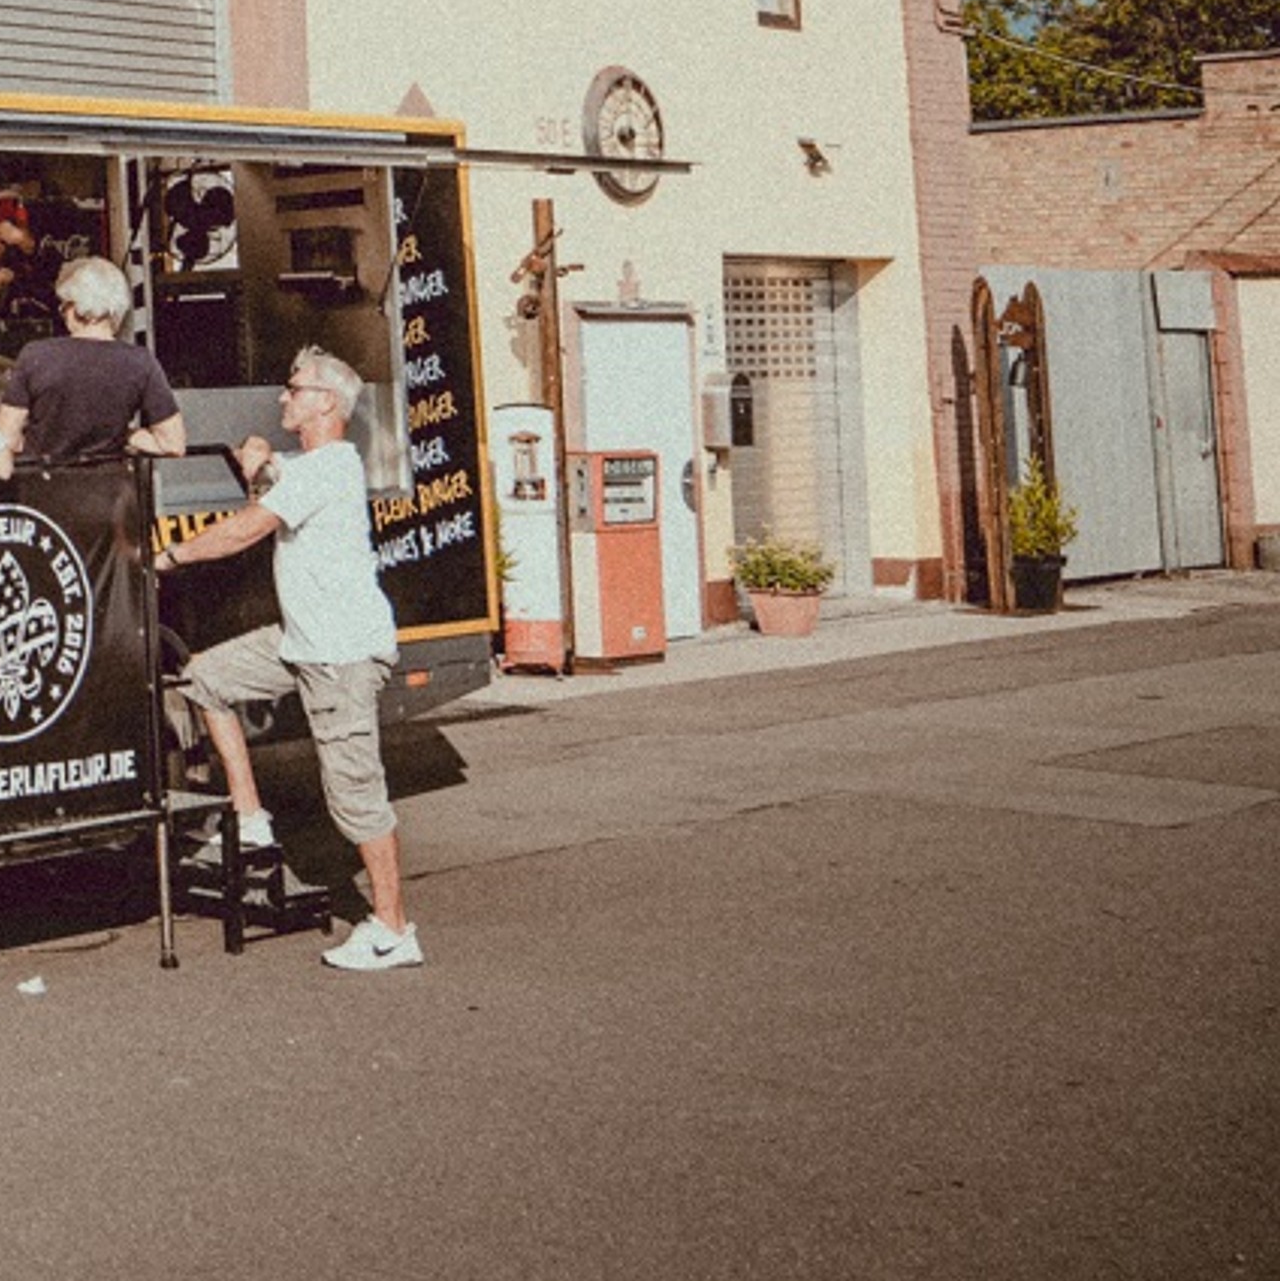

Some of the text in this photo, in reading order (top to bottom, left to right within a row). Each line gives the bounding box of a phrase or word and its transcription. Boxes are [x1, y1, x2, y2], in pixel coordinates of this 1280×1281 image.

[417, 469, 474, 515] BURGER
[50, 549, 85, 676] EST. 2016
